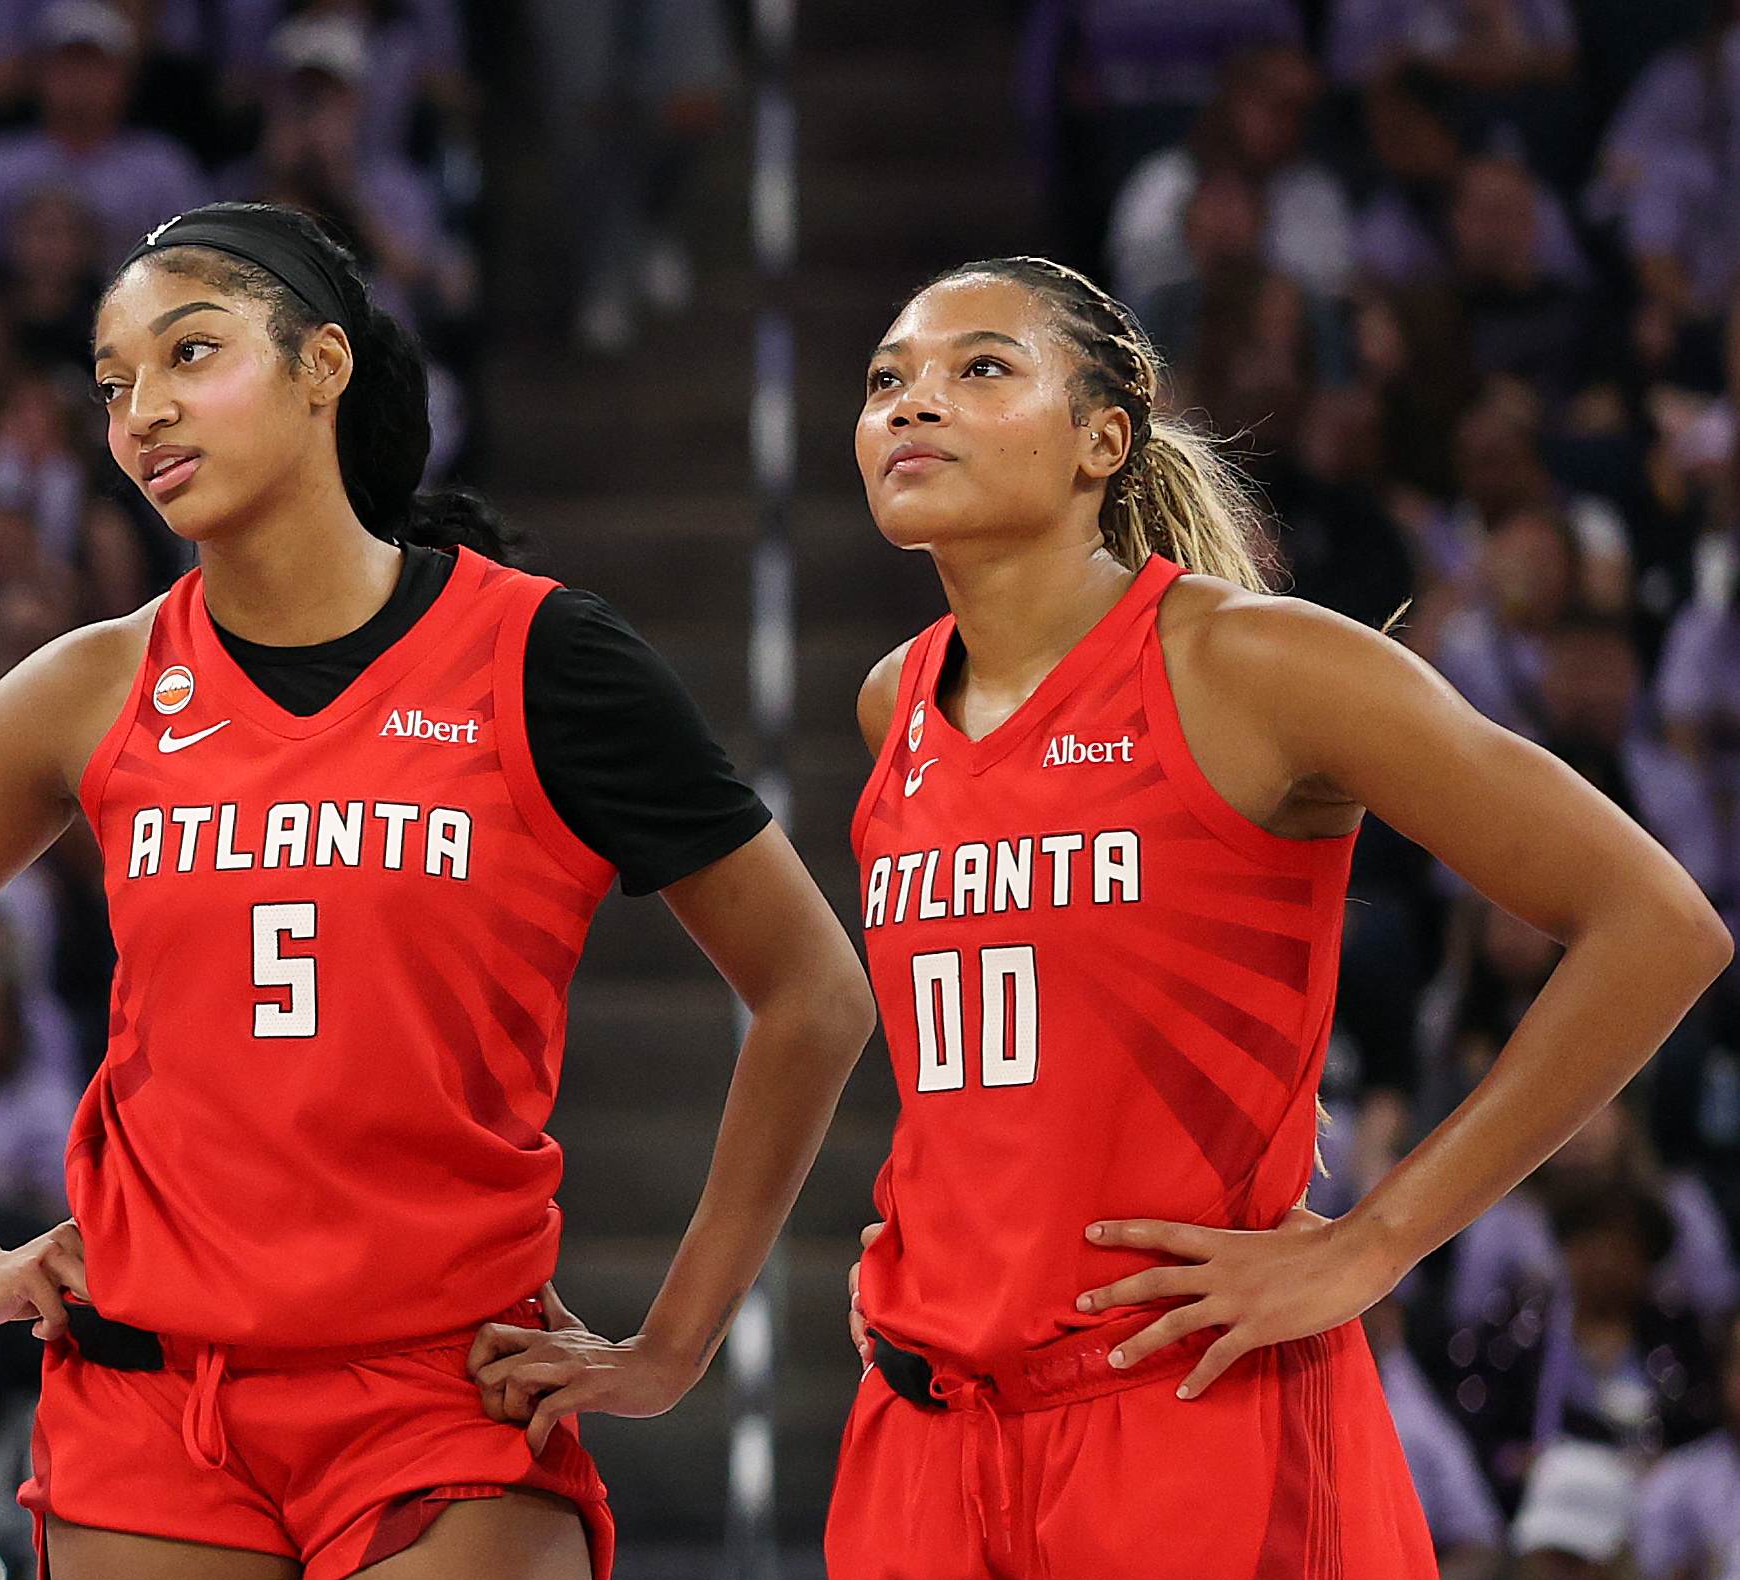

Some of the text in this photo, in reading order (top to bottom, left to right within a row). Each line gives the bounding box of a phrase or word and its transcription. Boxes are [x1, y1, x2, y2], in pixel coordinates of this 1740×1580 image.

[377, 708, 480, 746] Albert
[1041, 733, 1135, 769] Albert
[126, 801, 473, 882] ATLANTA
[863, 828, 1141, 930] ATLANTA
[251, 901, 318, 1039] 5
[910, 944, 1039, 1094] 00
